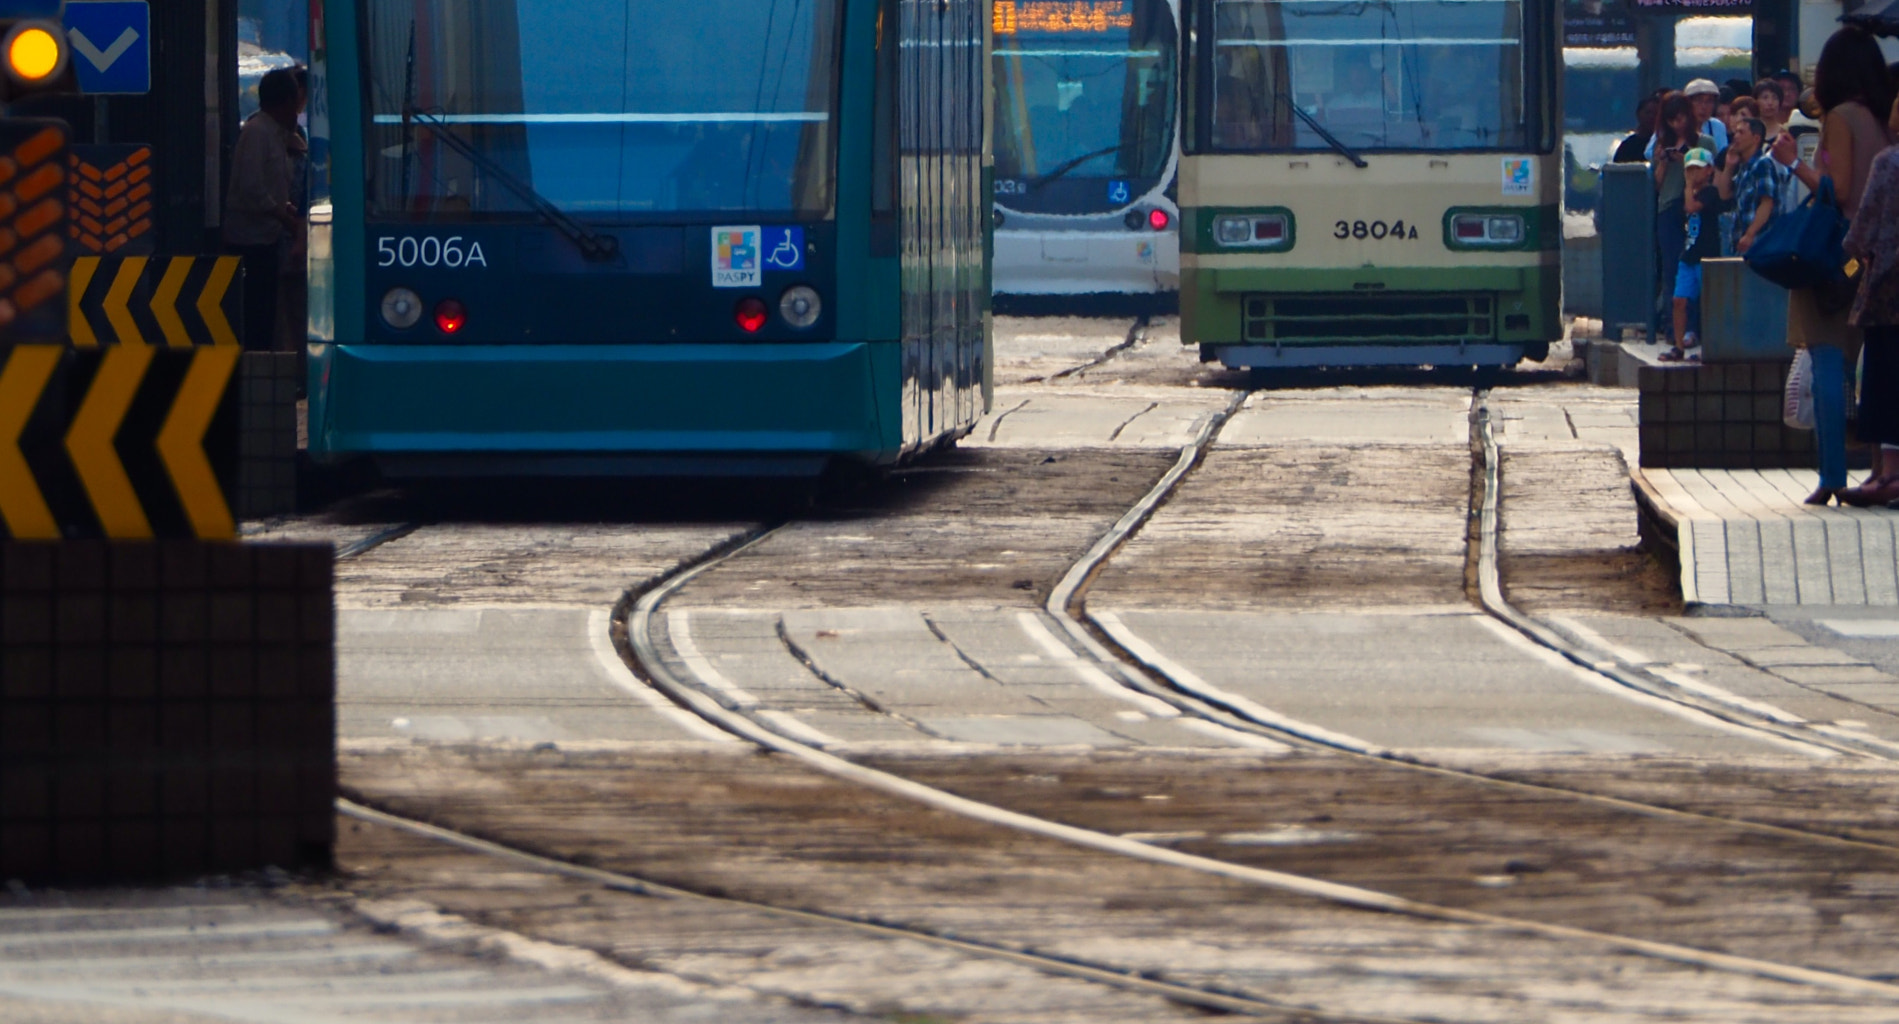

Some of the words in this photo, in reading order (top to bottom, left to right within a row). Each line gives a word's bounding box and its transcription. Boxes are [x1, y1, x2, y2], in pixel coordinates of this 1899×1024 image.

[1333, 219, 1419, 240] 3804A
[378, 236, 488, 267] 5006A
[717, 271, 756, 283] PASPY
